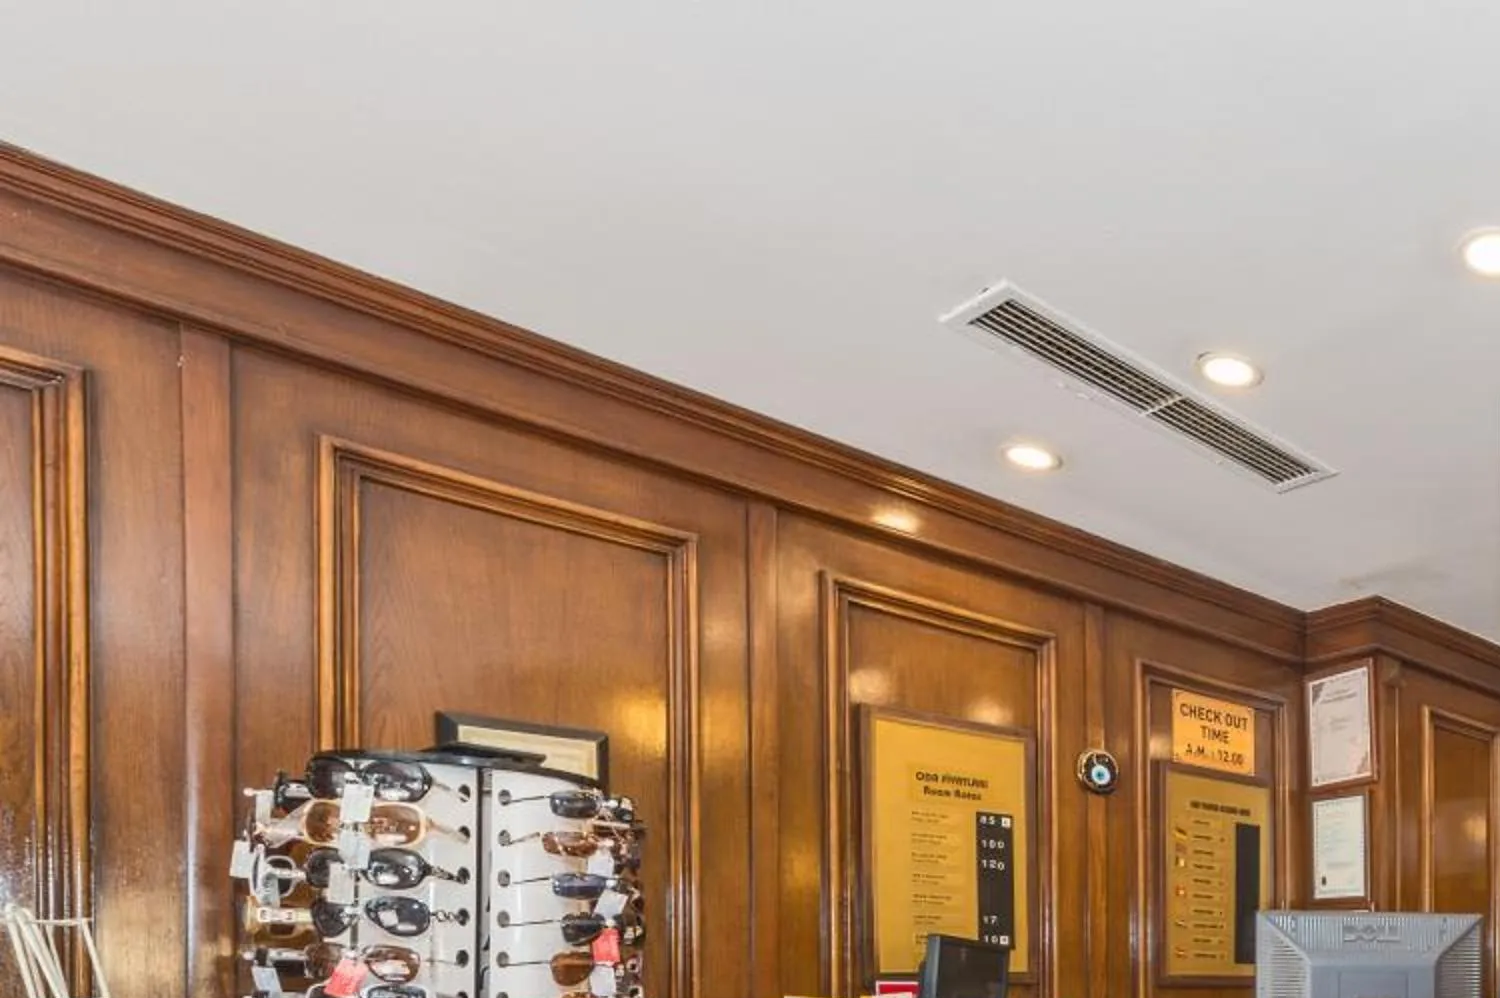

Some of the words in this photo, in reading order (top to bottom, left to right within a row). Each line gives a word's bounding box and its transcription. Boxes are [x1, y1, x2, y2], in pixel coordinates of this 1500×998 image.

[1180, 703, 1222, 725] CHECK
[1225, 713, 1248, 731] OUT
[1200, 725, 1230, 745] TIME
